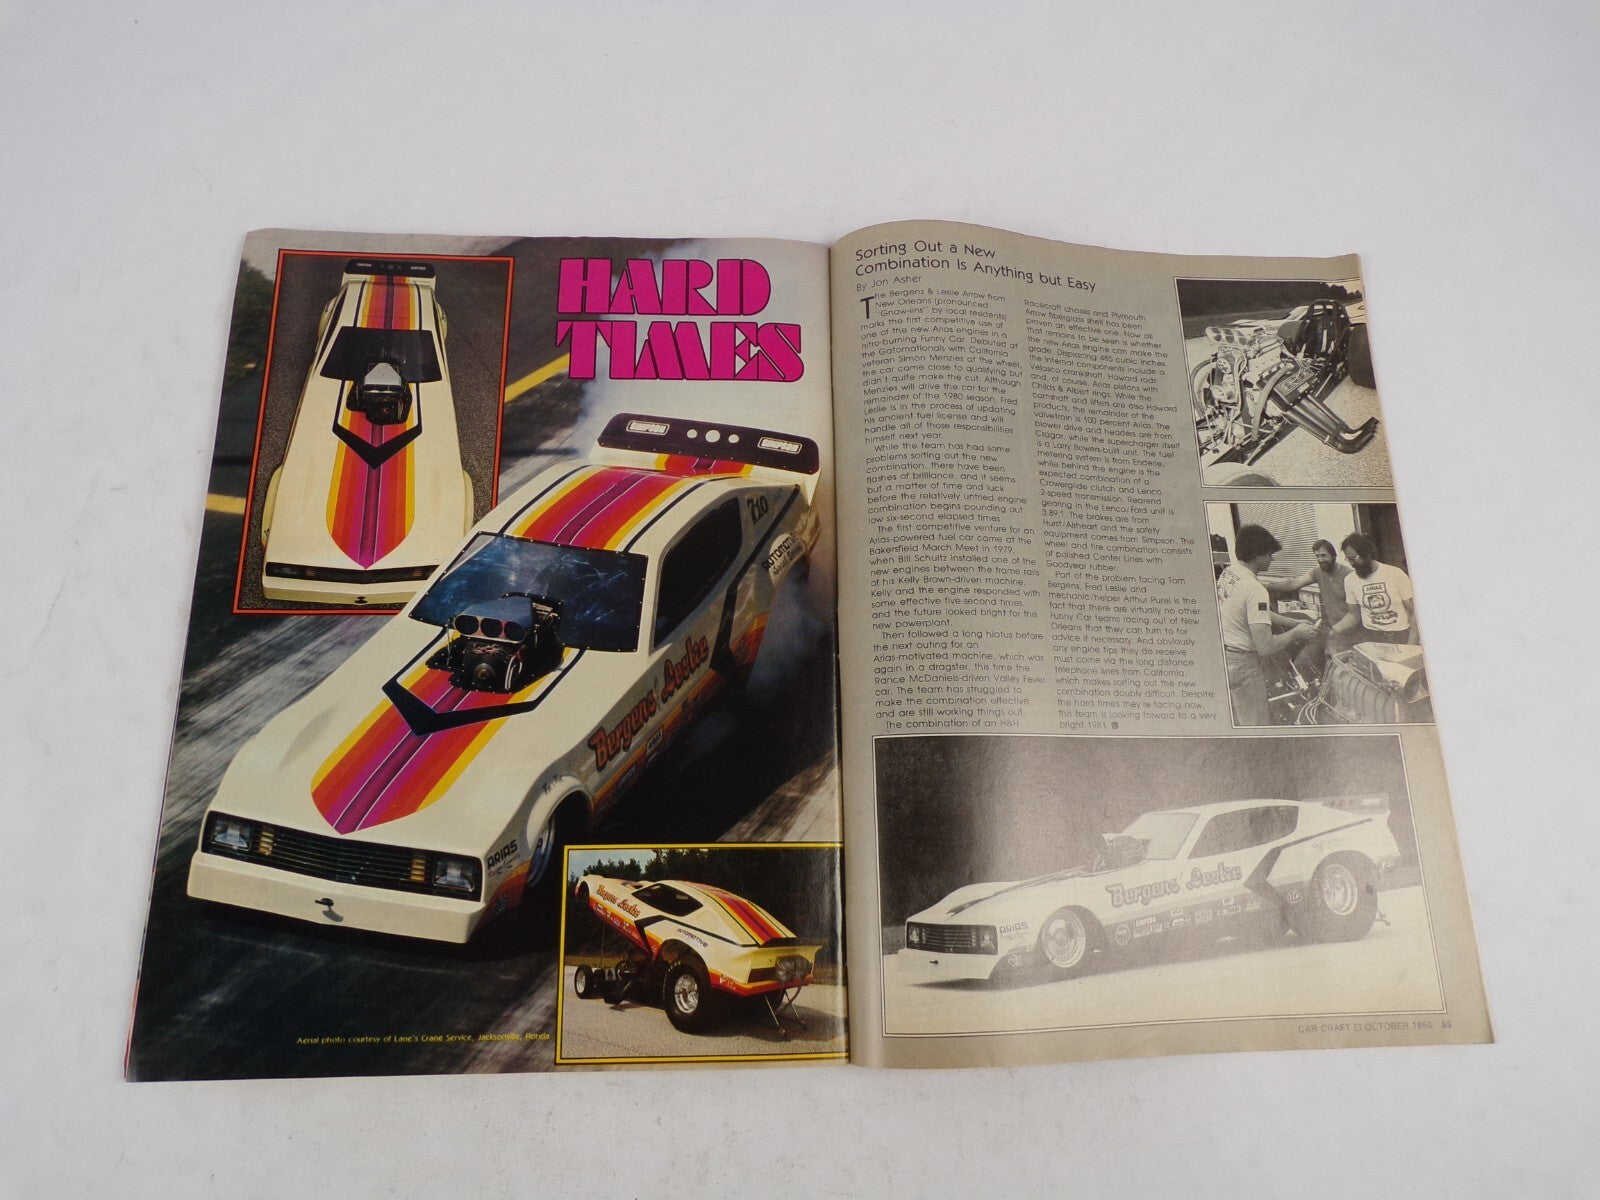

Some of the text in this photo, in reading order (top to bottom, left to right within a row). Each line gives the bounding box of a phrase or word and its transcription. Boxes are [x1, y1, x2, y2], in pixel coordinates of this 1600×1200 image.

[856, 240, 996, 261] Sorting Out a New
[855, 256, 1096, 293] Combination Is Anything but Easy
[557, 258, 771, 316] HARD
[856, 276, 922, 291] By Jon Asher
[1025, 307, 1143, 330] Arrow fiberglass shell has been
[555, 320, 804, 382] TIMES
[863, 385, 898, 396] Menzies
[901, 383, 915, 391] will
[918, 382, 940, 390] drive
[978, 385, 989, 393] for
[992, 386, 1006, 395] the
[864, 405, 887, 415] Leslie
[977, 405, 1016, 417] updating
[1072, 405, 1086, 414] the
[1088, 409, 1129, 418] remainder
[1141, 412, 1155, 420] the
[864, 424, 896, 435] handle
[900, 422, 911, 430] all
[926, 421, 950, 429] those
[953, 424, 1014, 434] responsibilities
[874, 443, 899, 452] While
[948, 441, 964, 449] has
[966, 442, 985, 450] had
[987, 445, 1011, 453] some
[866, 453, 908, 466] problems
[911, 451, 941, 460] sorting
[962, 452, 977, 460] the
[1037, 450, 1073, 462] metering
[1076, 454, 1102, 463] system
[1112, 456, 1130, 465] from
[931, 461, 954, 469] there
[957, 462, 979, 470] have
[982, 463, 1005, 472] been
[1037, 459, 1059, 468] while
[1061, 461, 1090, 471] behind
[1092, 464, 1106, 473] the
[1108, 467, 1136, 476] engine
[867, 485, 882, 494] but
[896, 482, 927, 490] matter
[943, 481, 963, 489] time
[987, 483, 1004, 492] luck
[1039, 478, 1162, 496] Crowerglide clutch and Lenco
[867, 492, 1027, 505] before the relatively untried engine
[747, 495, 768, 525] 710
[878, 525, 893, 533] The
[916, 523, 971, 532] competitive
[974, 525, 1007, 533] venture
[1009, 526, 1021, 534] for
[1056, 551, 1090, 560] polished
[1092, 553, 1121, 562] Center
[1123, 555, 1144, 563] Lines
[1146, 556, 1163, 564] with
[1045, 559, 1087, 571] Goodyear
[1049, 601, 1066, 609] fact
[1068, 602, 1086, 610] that
[1089, 604, 1111, 612] there
[1130, 606, 1162, 616] virtually
[1178, 607, 1200, 615] other
[872, 622, 892, 630] new
[882, 631, 904, 639] Then
[908, 630, 949, 638] followed
[962, 630, 983, 639] long
[986, 630, 1013, 638] hiatus
[1015, 631, 1044, 640] before
[873, 643, 888, 651] the
[892, 642, 913, 650] next
[916, 641, 948, 650] outing
[1055, 665, 1098, 675] telephone
[1100, 667, 1120, 675] lines
[487, 839, 518, 870] ARIAS
[1000, 921, 1028, 934] ARIAS
[1298, 1025, 1317, 1033] CAR
[1321, 1023, 1350, 1032] CRAFT
[1364, 1021, 1409, 1031] OCTOBER
[321, 1037, 345, 1045] photo
[348, 1036, 380, 1044] courtesy
[421, 1034, 443, 1042] Crane
[446, 1034, 475, 1043] Service,
[525, 1033, 550, 1041] Florida
